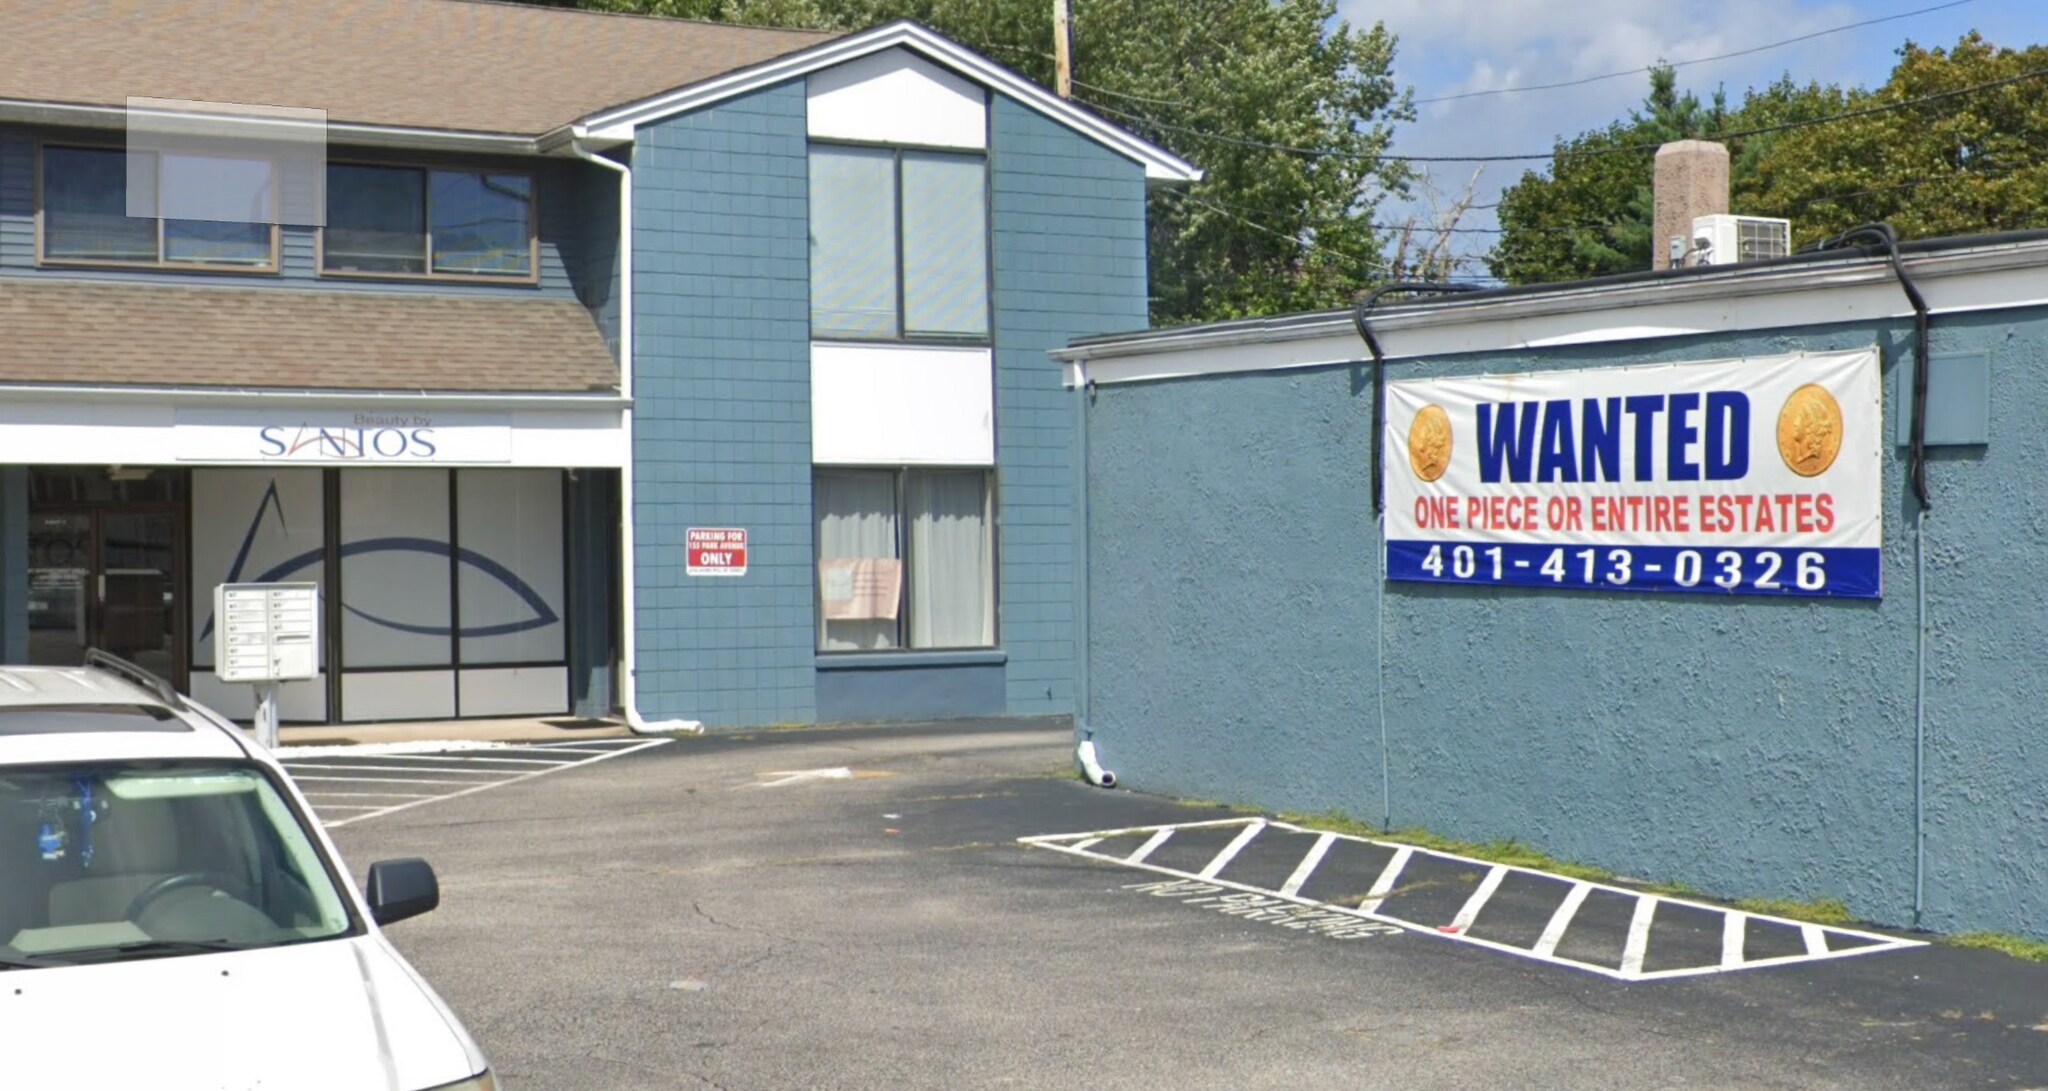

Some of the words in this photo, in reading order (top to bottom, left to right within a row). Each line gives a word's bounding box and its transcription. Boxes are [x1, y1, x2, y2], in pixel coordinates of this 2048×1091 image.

[354, 413, 409, 426] Beauty
[413, 413, 432, 427] by
[259, 422, 436, 458] SANTOS
[1476, 391, 1750, 483] WANTED
[1414, 496, 1460, 528] ONE
[1467, 496, 1538, 530] PIECE
[1547, 496, 1582, 531] OR
[1591, 495, 1690, 532] ENTIRE
[1699, 493, 1835, 533] ESTATES
[690, 531, 726, 541] PARKING
[727, 531, 743, 541] FOR
[701, 541, 718, 550] PARK
[720, 541, 745, 550] AVENUE
[701, 552, 732, 565] ONLY
[1421, 544, 1826, 590] 401-413-0326
